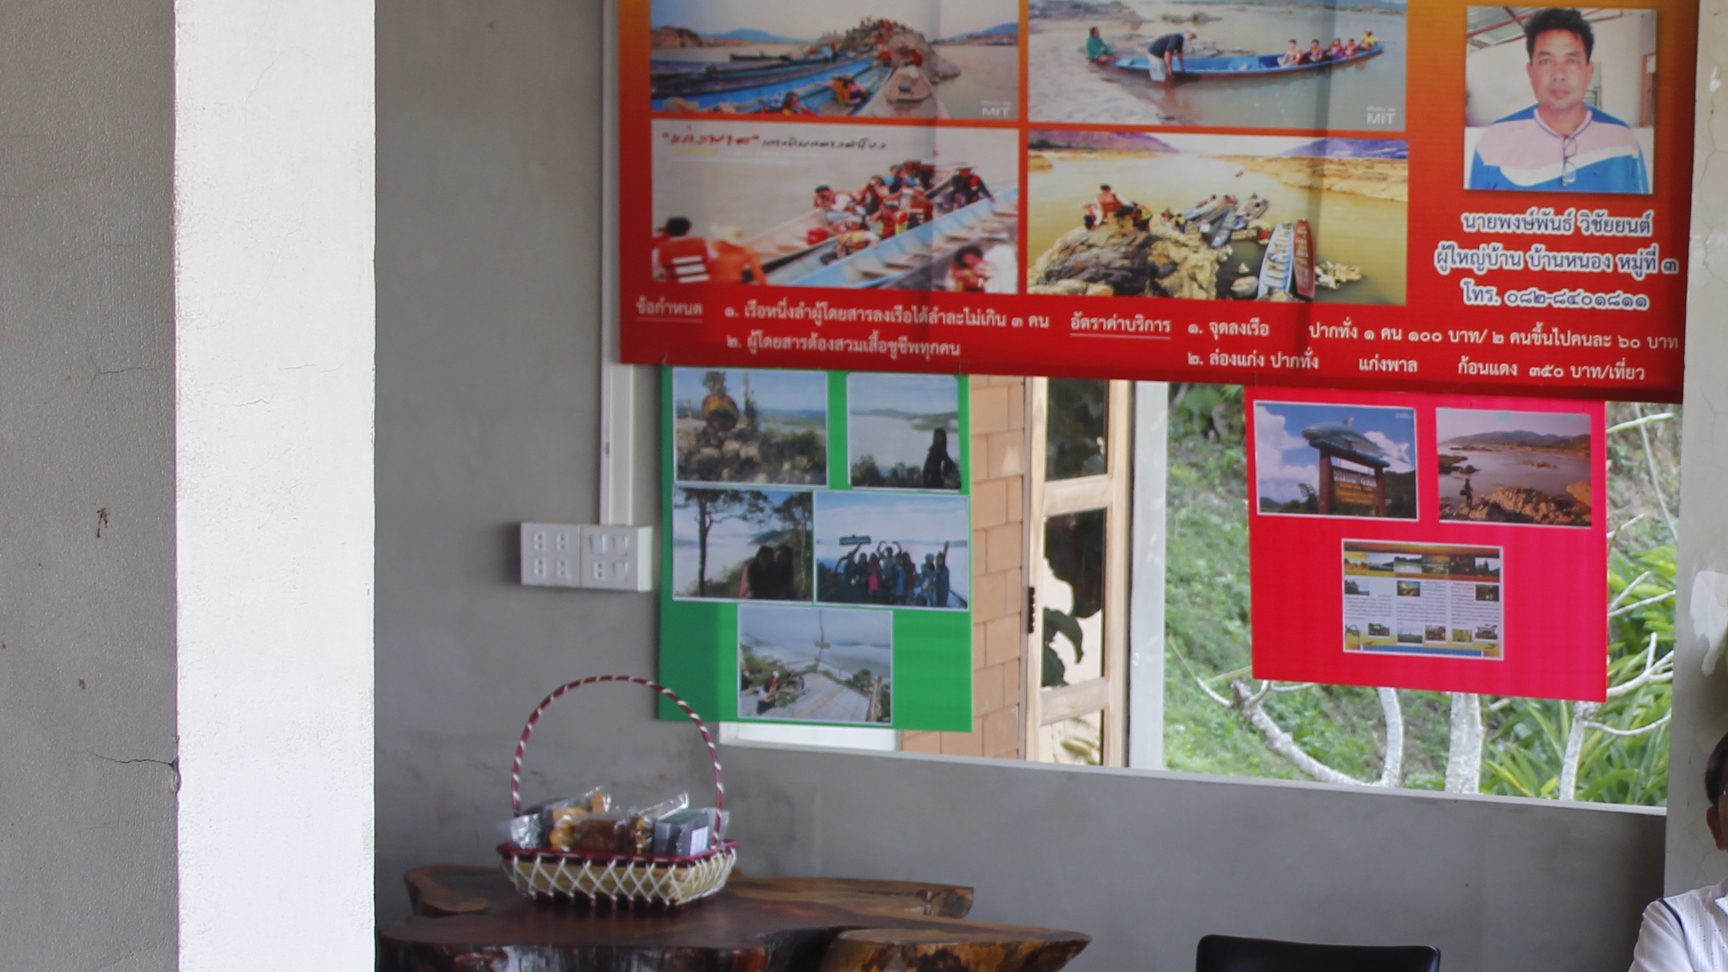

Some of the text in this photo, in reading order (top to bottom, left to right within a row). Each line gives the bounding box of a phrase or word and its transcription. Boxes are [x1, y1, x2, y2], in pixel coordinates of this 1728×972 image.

[1366, 113, 1396, 125] MIT
[1462, 207, 1653, 235] นายพงษ์พันธ์ วิชัยยนต์
[1436, 243, 1678, 279] ผู้ใหญ่บ้าน บ้านหนอง หมู่ที่ ๓
[1463, 280, 1499, 304] โทร.
[1028, 314, 1050, 328] คน
[1070, 312, 1171, 333] อัตราค่าบริการ
[1209, 317, 1270, 341] จุดลงเรือ
[1380, 327, 1403, 341] คน
[1407, 331, 1443, 343] ๑๐๐
[1447, 329, 1487, 344] บาท/
[1509, 321, 1613, 348] คนขึ้นไปคนละ
[1646, 335, 1679, 349] บาท
[1209, 349, 1265, 367] ล่องแก่ง
[1358, 354, 1418, 373] แก่งพาล
[1458, 355, 1518, 377] ก้อนแดง
